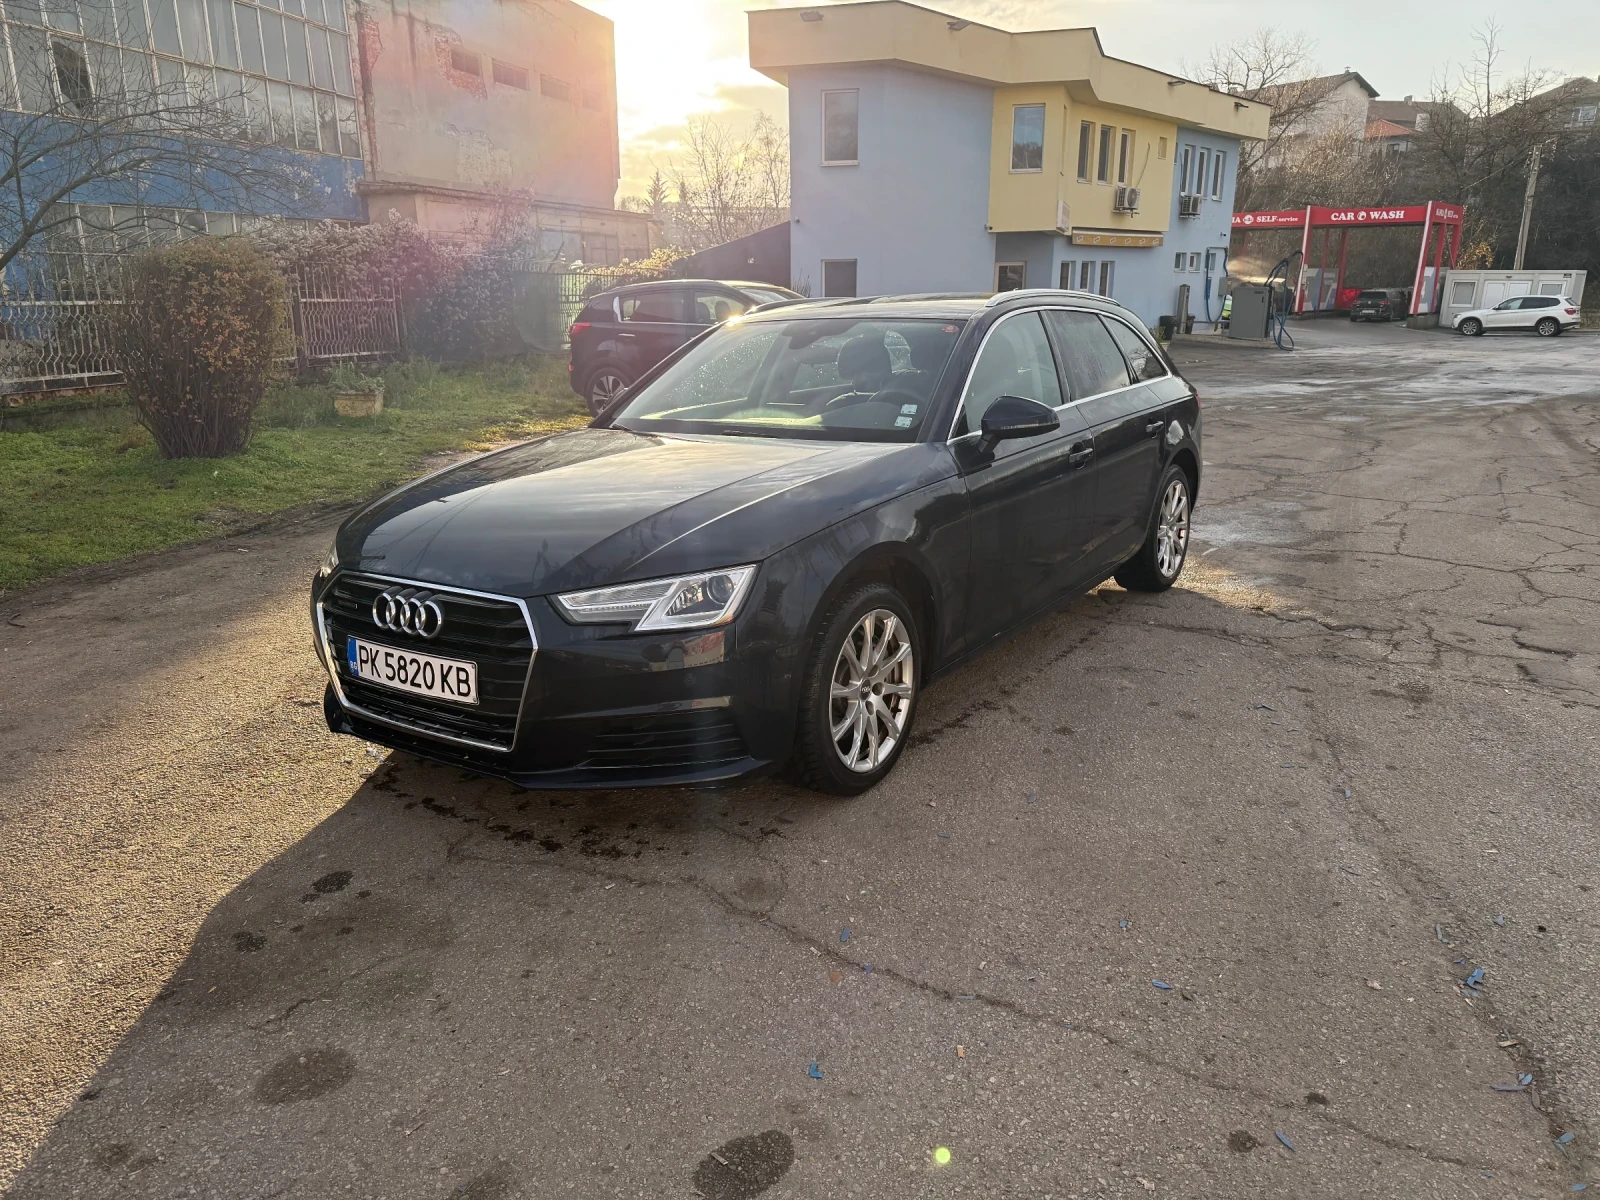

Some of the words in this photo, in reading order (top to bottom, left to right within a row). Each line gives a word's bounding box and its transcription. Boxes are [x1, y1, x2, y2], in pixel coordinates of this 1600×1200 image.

[1231, 216, 1241, 224] IA
[1256, 215, 1298, 223] SELF-service
[1331, 212, 1355, 221] CAR
[1370, 210, 1405, 220] WASH
[350, 660, 357, 670] BG
[358, 644, 381, 679] PK
[385, 651, 435, 690] 5820
[440, 663, 471, 697] KB
